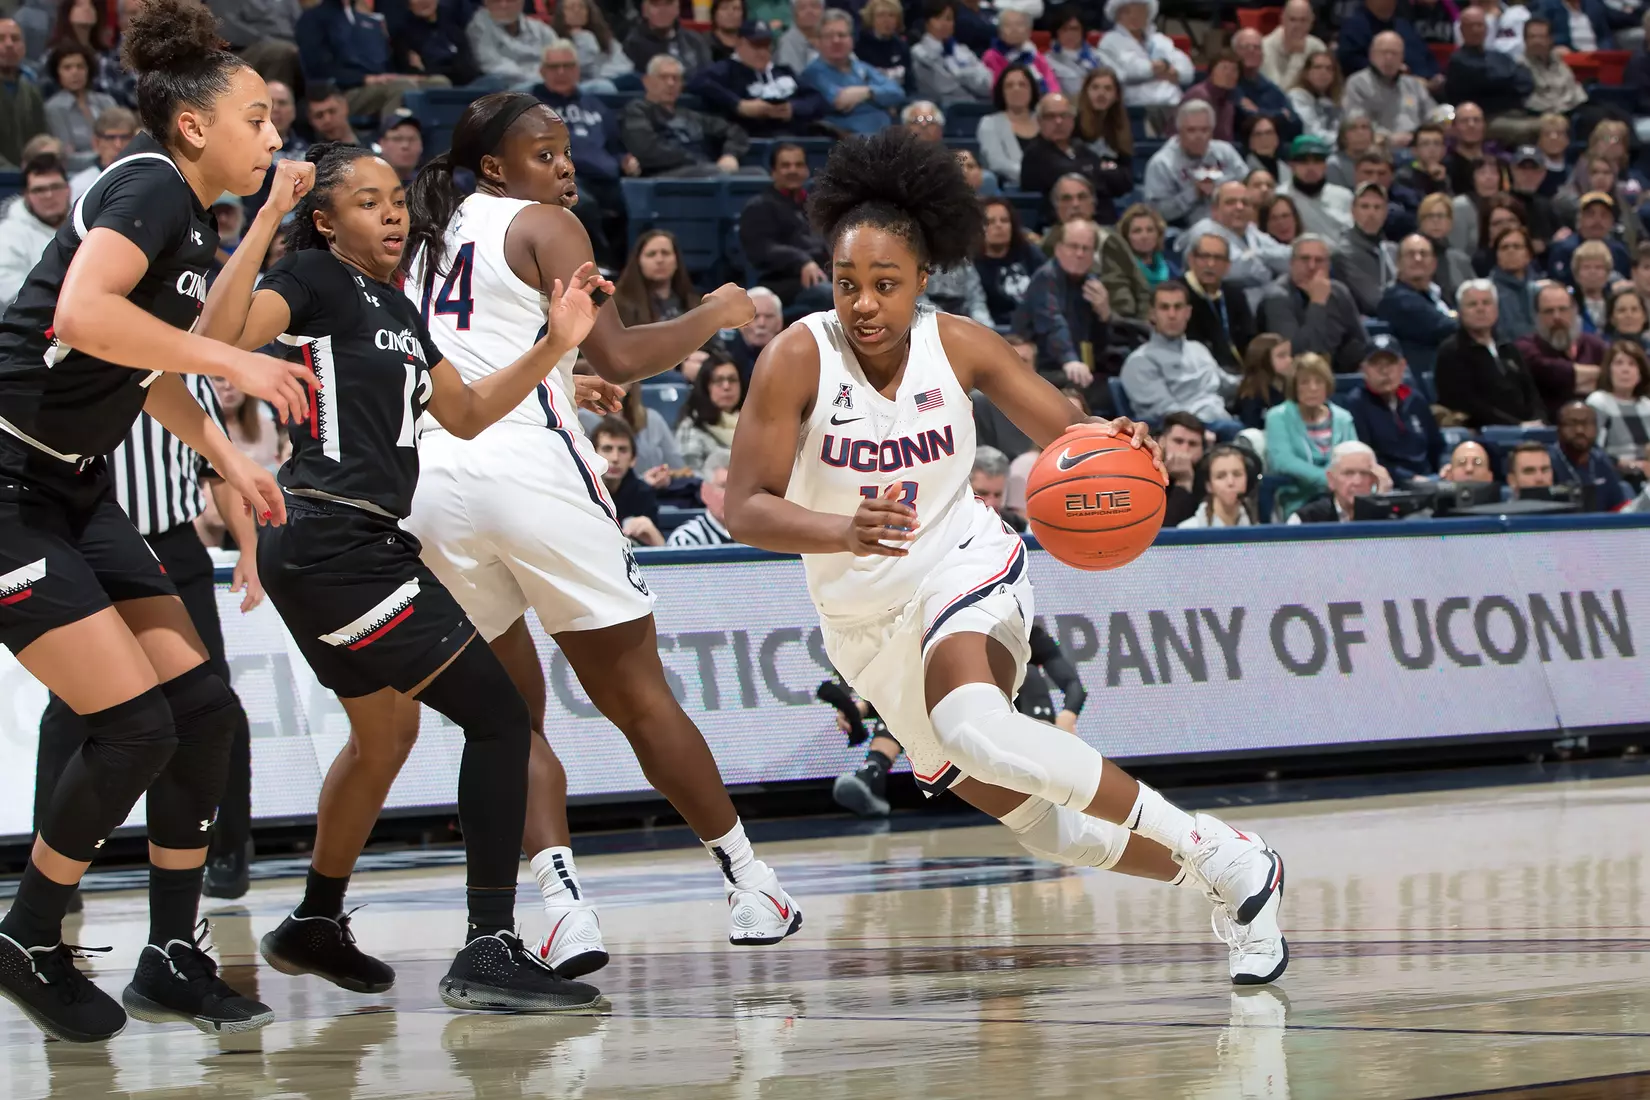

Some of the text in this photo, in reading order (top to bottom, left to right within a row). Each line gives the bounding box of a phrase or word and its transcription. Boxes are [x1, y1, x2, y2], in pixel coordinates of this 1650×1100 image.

[411, 241, 475, 331] 14
[820, 424, 955, 473] UCONN
[1065, 490, 1131, 511] ELITE
[1066, 508, 1132, 517] CHAMPIONSHIP
[1033, 606, 1245, 690] PANY
[1269, 601, 1367, 677] OF
[1383, 589, 1636, 670] UCONN
